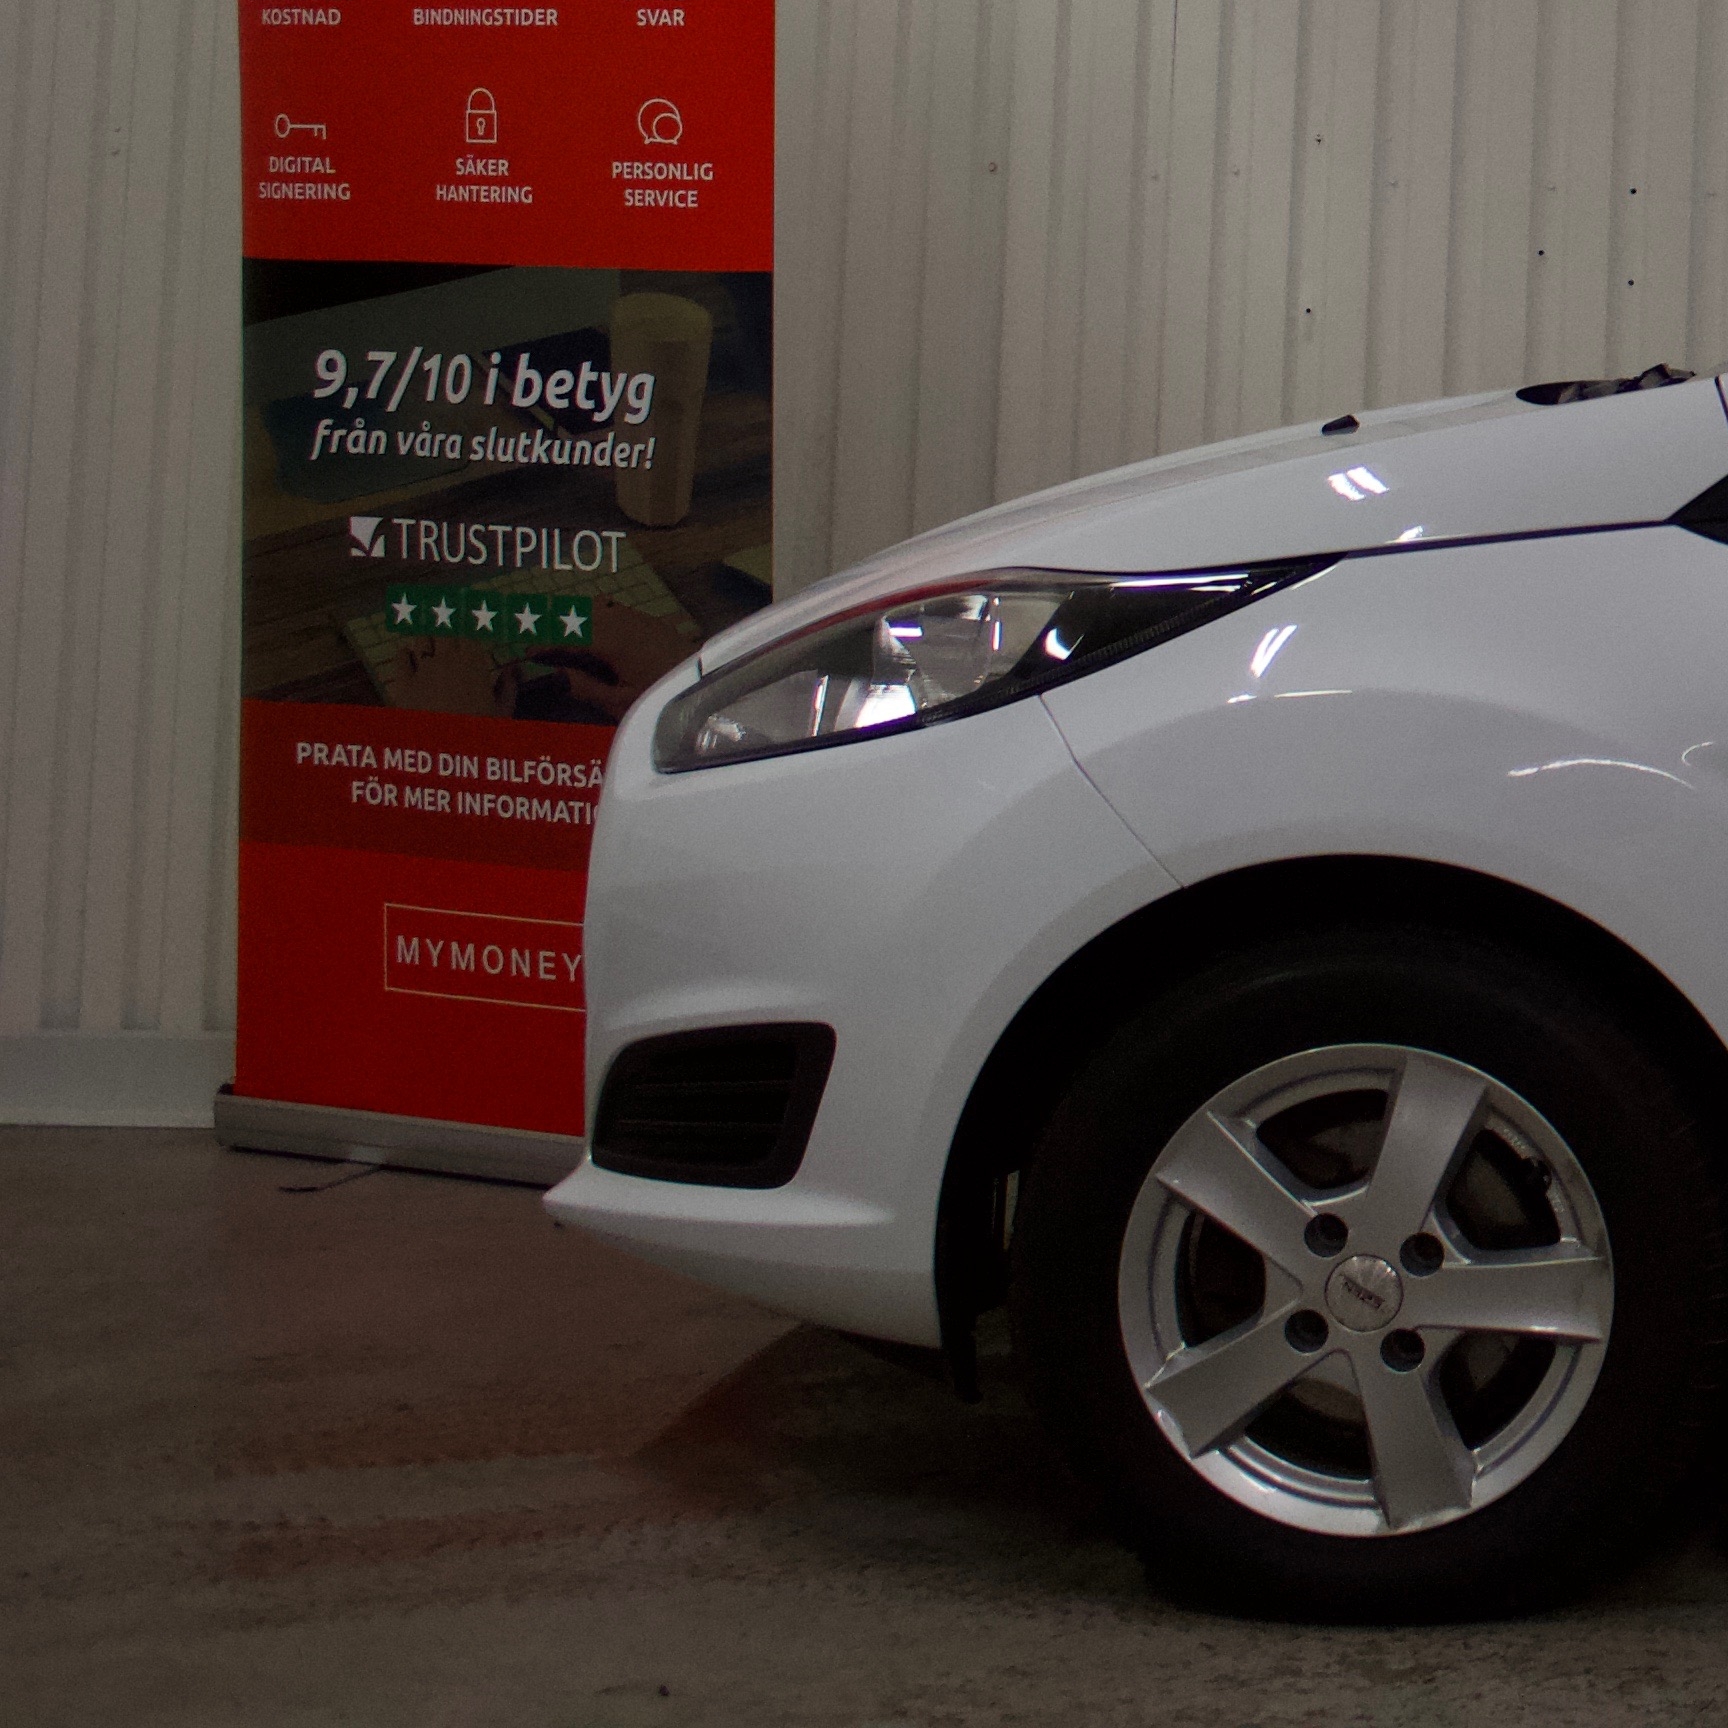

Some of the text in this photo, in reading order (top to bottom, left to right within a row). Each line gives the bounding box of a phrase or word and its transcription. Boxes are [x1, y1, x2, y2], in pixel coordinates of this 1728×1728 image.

[261, 8, 342, 26] KOSTNAD
[413, 8, 558, 26] BINDNINGSTIDER
[636, 8, 685, 27] SVAR
[268, 155, 336, 174] DIGITAL
[455, 154, 509, 177] SÄKER
[611, 161, 714, 181] PERSONLIG
[259, 181, 351, 201] SIGNERING
[436, 184, 533, 204] HANTERING
[624, 188, 698, 208] SERVICE
[313, 346, 655, 425] 9,7/10 i betyg
[310, 417, 656, 470] från våra slutkunder!
[392, 518, 627, 573] TRUSTPILOT
[296, 741, 378, 769] PRATA
[383, 747, 433, 774] MED
[438, 752, 479, 779] DIN
[351, 775, 398, 807] FÖR
[404, 785, 451, 813] MER
[396, 935, 583, 982] MYMONEY
